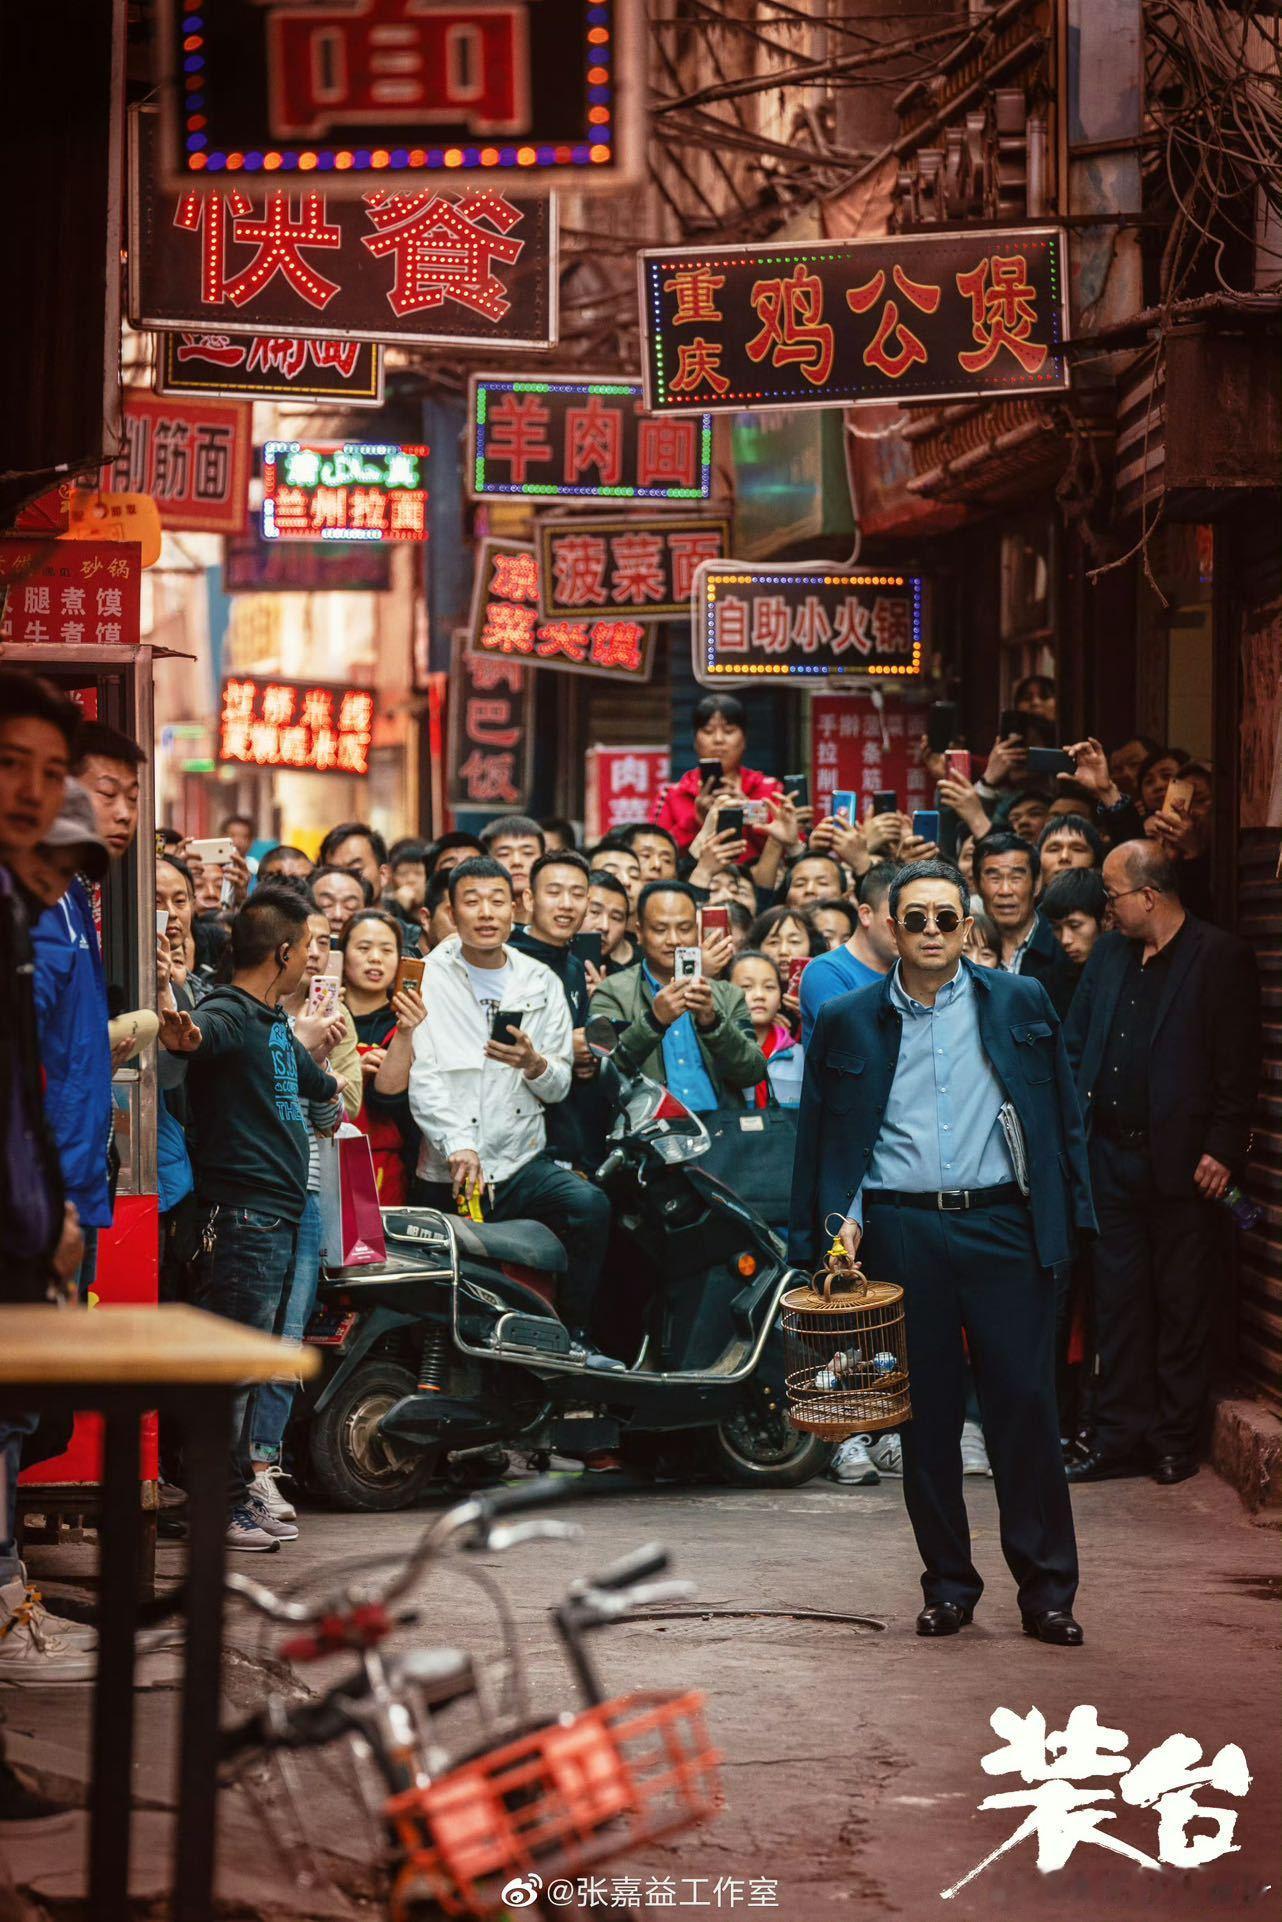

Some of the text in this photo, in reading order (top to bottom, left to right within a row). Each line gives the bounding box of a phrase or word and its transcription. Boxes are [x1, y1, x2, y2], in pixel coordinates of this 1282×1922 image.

[172, 186, 524, 322] 快餐
[664, 267, 731, 395] 重庆
[745, 254, 1049, 387] 鸡公煲
[487, 395, 699, 488] 羊肉面
[79, 556, 131, 580] 砂锅
[553, 532, 722, 606] 菠菜面
[715, 596, 911, 656] 自助小火锅
